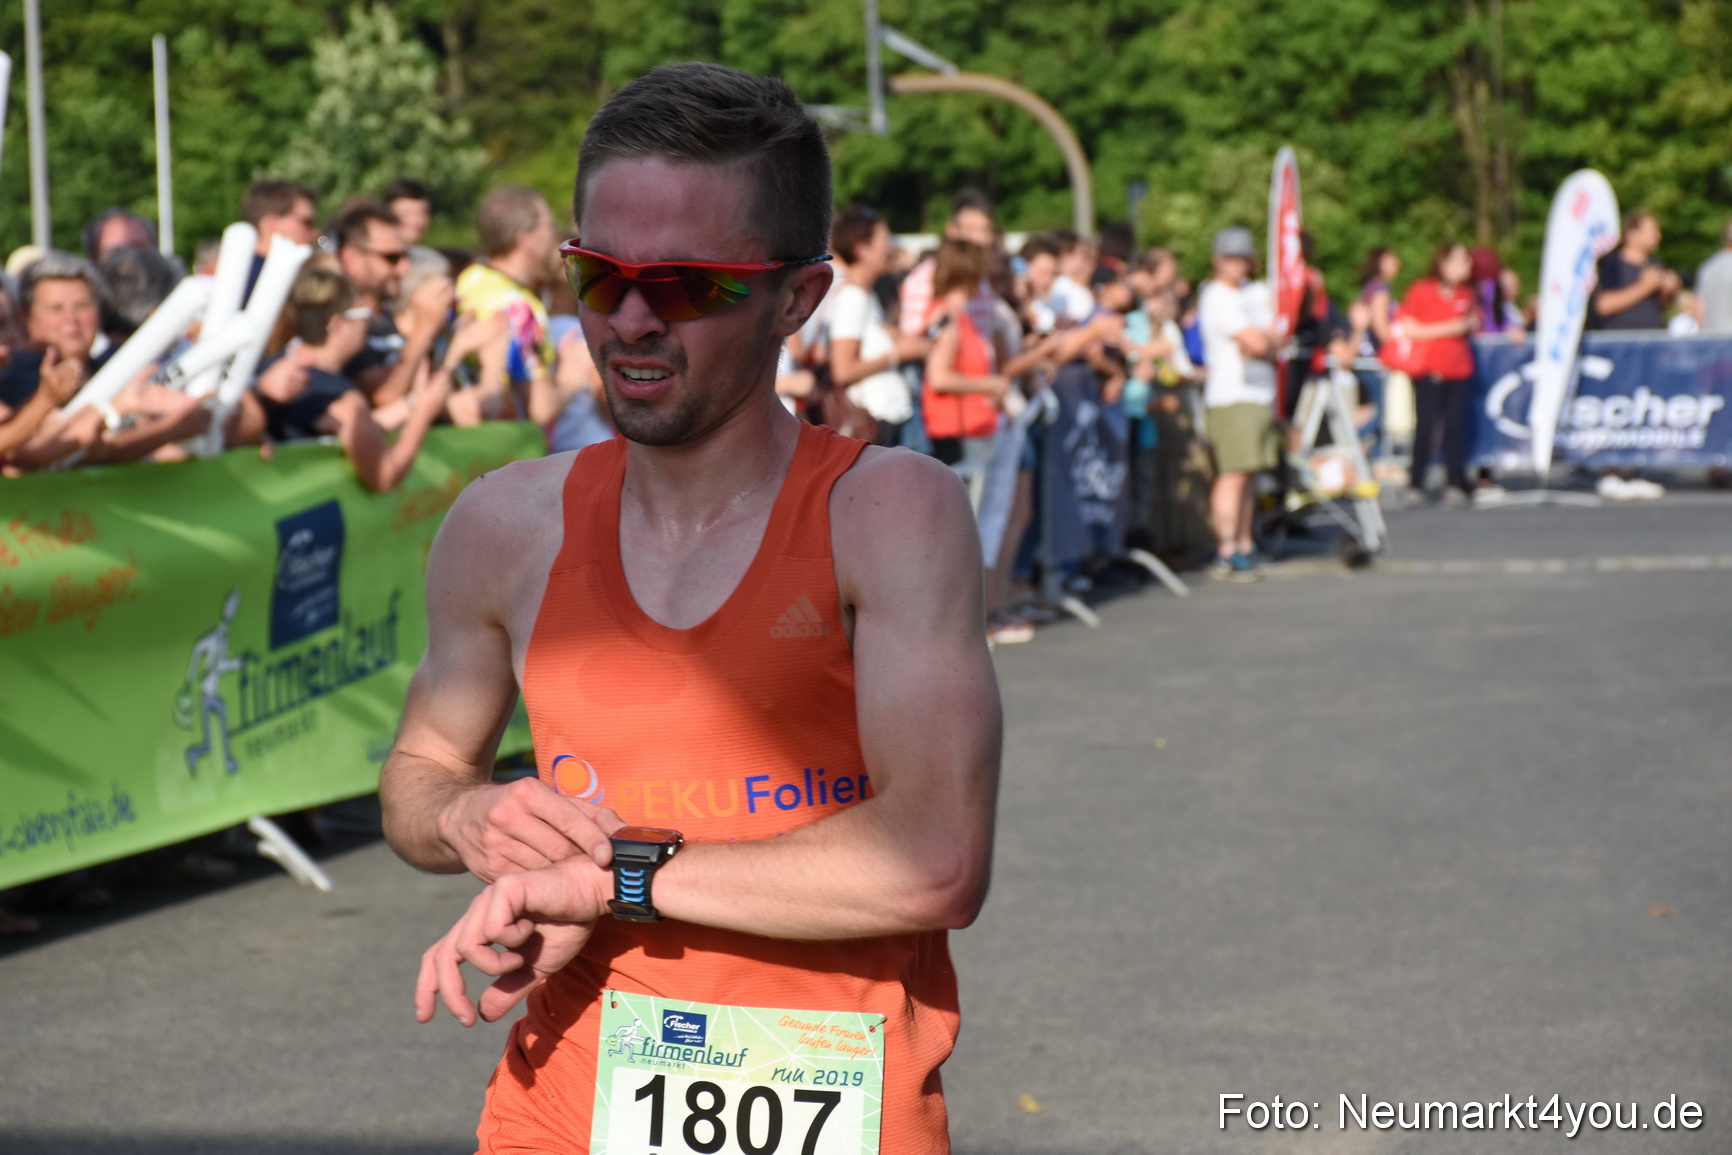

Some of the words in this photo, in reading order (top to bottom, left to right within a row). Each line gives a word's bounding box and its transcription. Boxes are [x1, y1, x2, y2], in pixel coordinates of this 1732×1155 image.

[769, 623, 830, 639] adidas
[670, 1019, 701, 1030] Fischer
[778, 1015, 827, 1034] Gesunde
[829, 1025, 867, 1042] Firmen
[798, 1033, 833, 1051] laufen
[641, 1037, 749, 1067] firmenlauf
[641, 1057, 686, 1070] neumarkt
[771, 1067, 806, 1084] run
[813, 1069, 864, 1087] 2019
[634, 1074, 842, 1155] 1807
